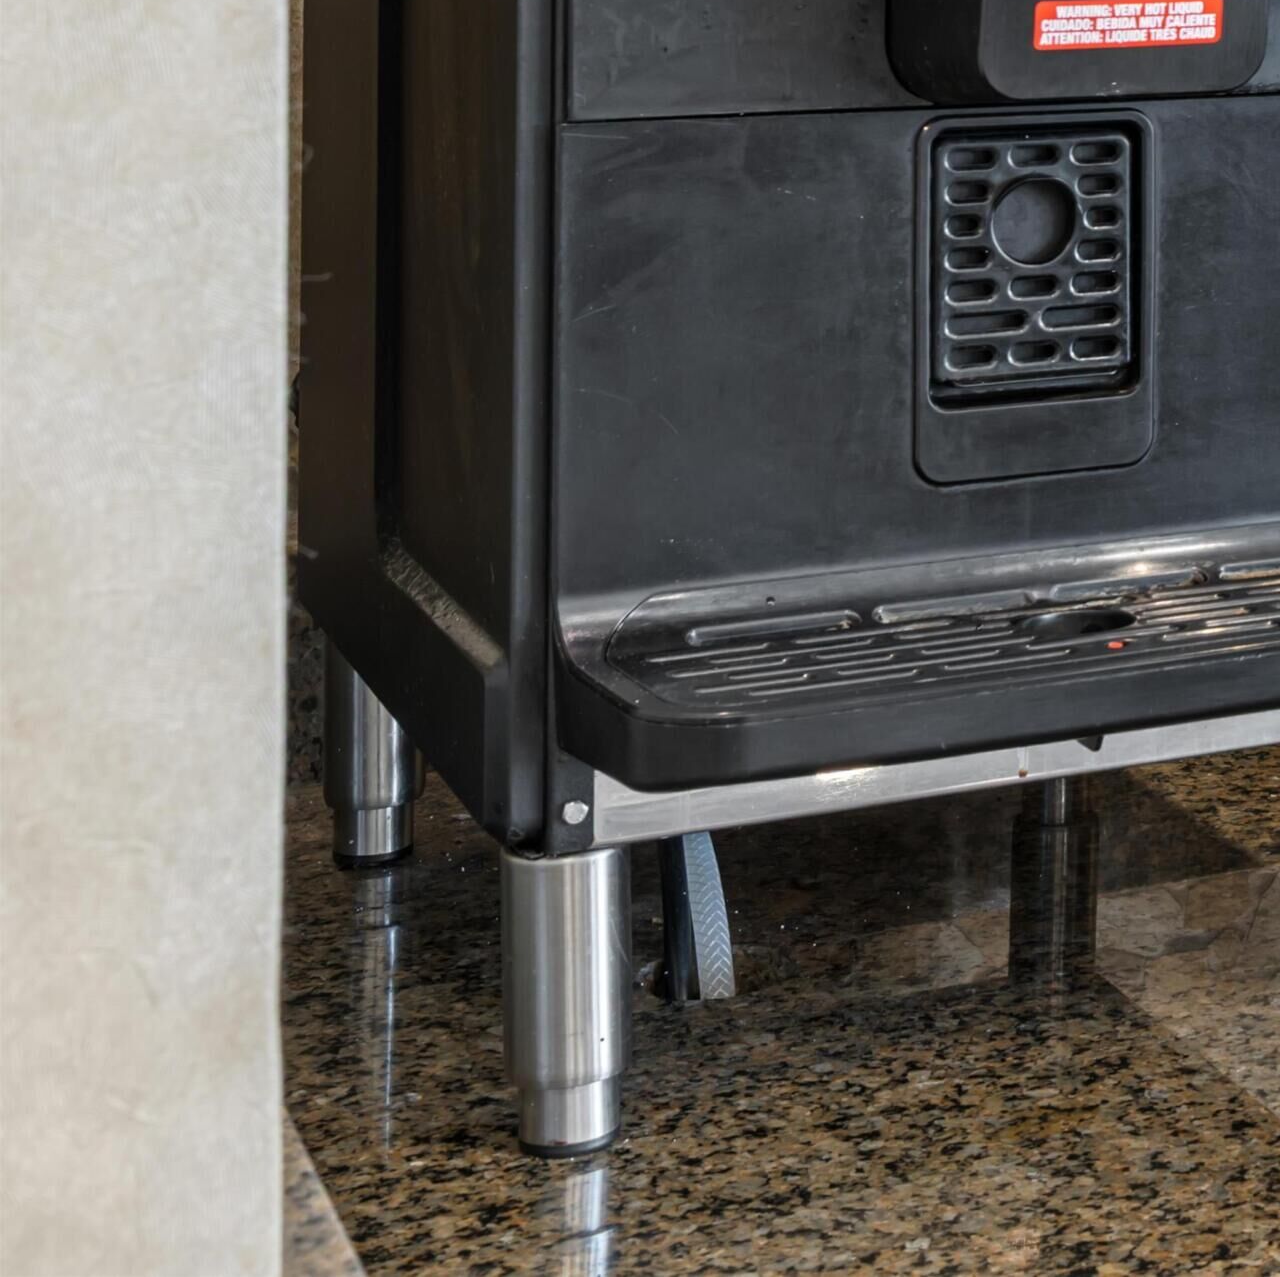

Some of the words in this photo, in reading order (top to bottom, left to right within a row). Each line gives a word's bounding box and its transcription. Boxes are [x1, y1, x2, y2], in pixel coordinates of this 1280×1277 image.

[1056, 5, 1112, 18] WARNING:
[1114, 3, 1143, 16] VERY
[1145, 2, 1167, 15] HOT
[1169, 1, 1204, 14] LIQUID
[1041, 19, 1094, 31] CUIDADO:
[1096, 17, 1137, 30] BEBIDA
[1139, 15, 1165, 28] MUY
[1166, 14, 1216, 27] CALIENTE
[1040, 31, 1103, 45] ATTENTION:
[1105, 30, 1147, 43] LIQUIDE
[1179, 27, 1216, 39] CHAUD
